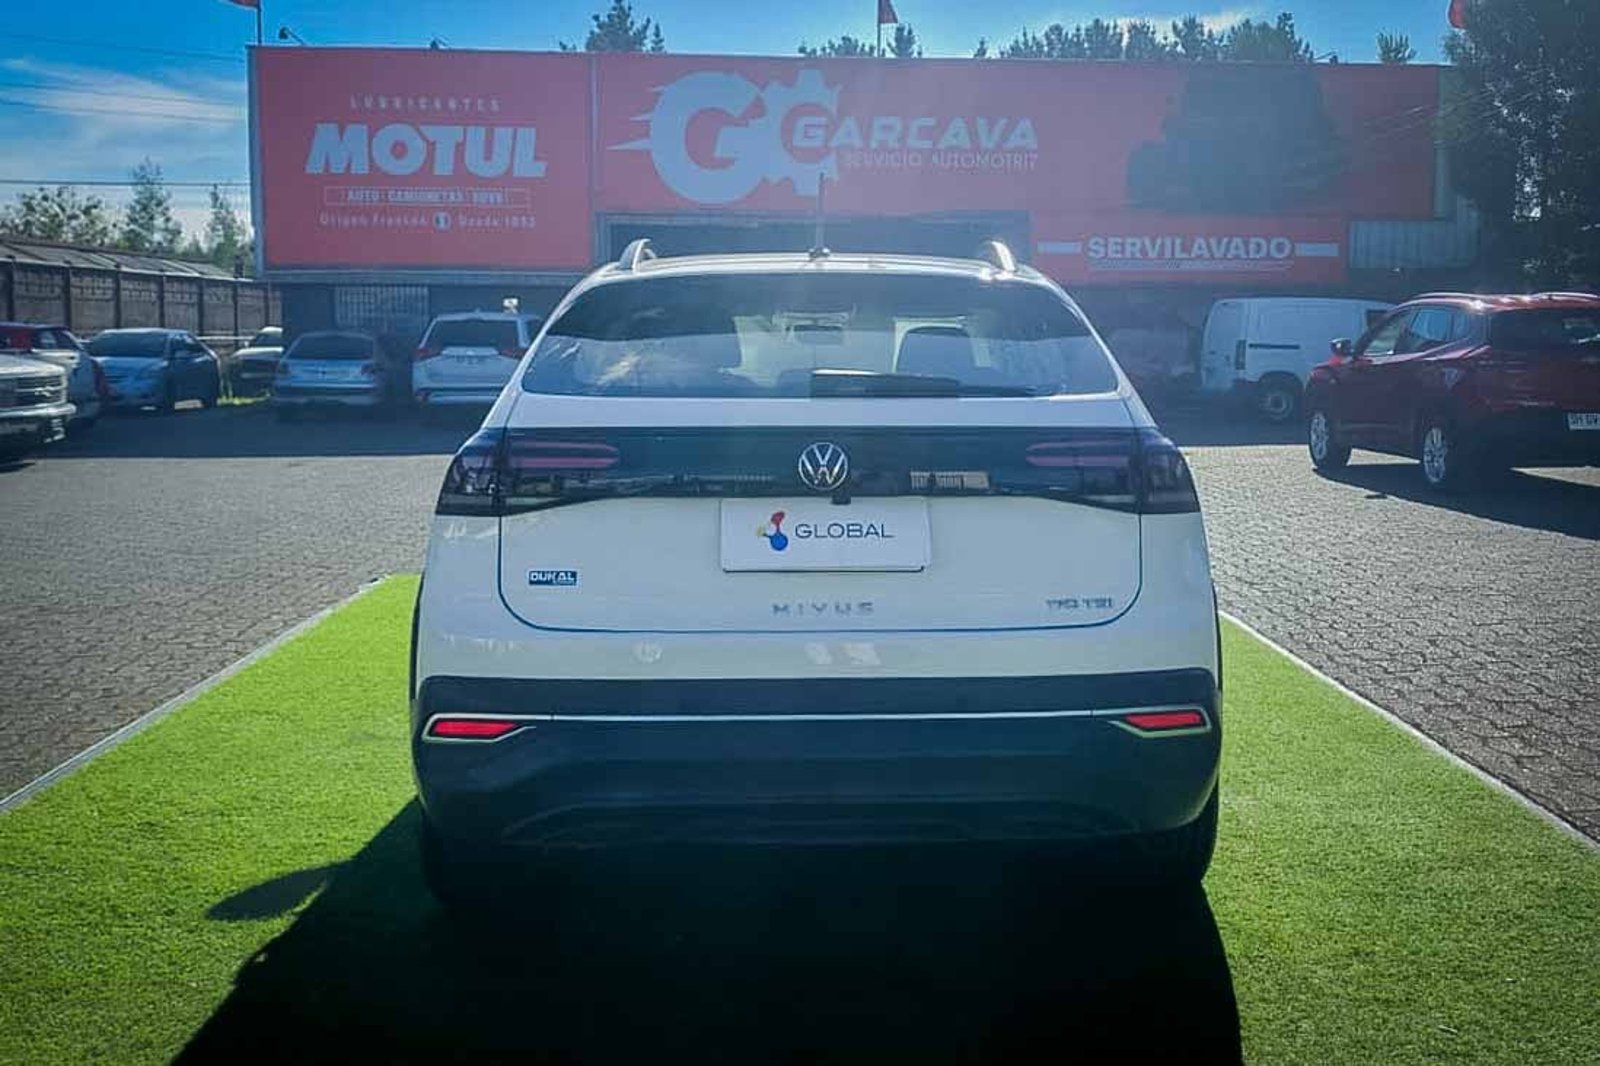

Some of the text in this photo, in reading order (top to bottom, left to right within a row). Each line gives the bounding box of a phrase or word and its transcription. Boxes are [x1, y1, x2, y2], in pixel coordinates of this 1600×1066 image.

[792, 115, 1038, 150] GARCAVA
[305, 123, 548, 177] MOTUL
[1087, 236, 1293, 259] SERVILAVADO
[795, 523, 894, 539] GLOBAL
